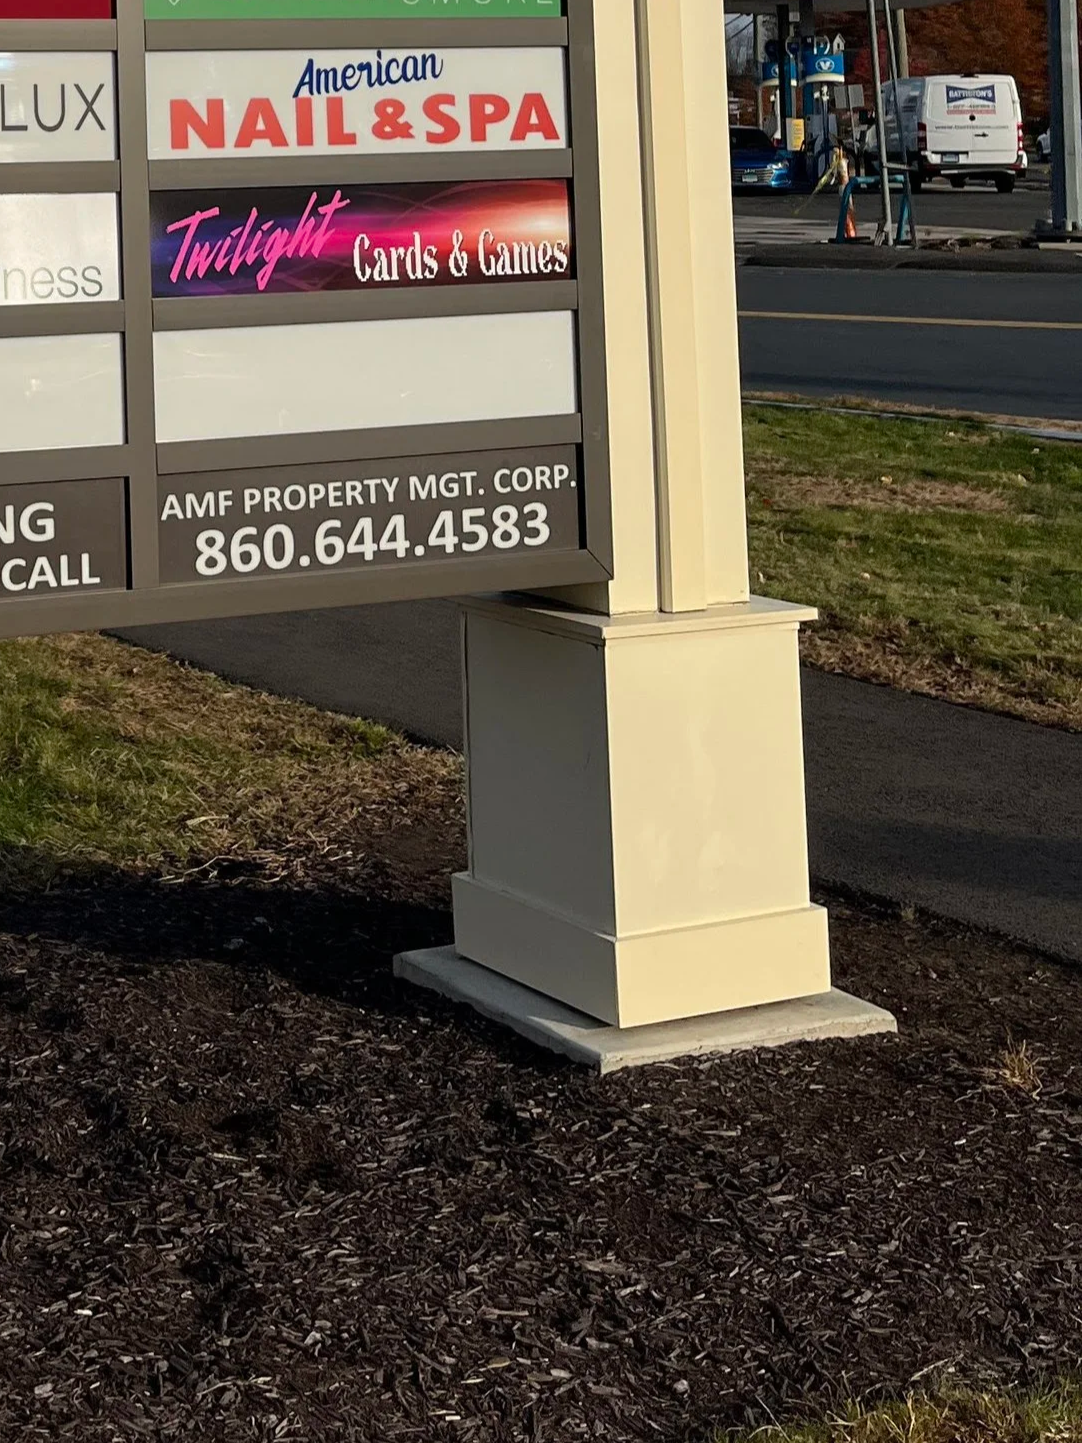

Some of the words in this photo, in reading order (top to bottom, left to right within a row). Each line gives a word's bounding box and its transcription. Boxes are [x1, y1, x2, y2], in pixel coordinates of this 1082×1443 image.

[292, 49, 444, 98] American
[0, 83, 106, 132] LUX
[166, 188, 351, 291] Twilight
[353, 232, 438, 282] Cards
[448, 229, 468, 278] &
[478, 228, 568, 277] Games
[160, 489, 234, 521] AMF
[243, 476, 399, 514] PROPERTY
[408, 470, 486, 501] MGT.
[493, 463, 578, 494] CORP.
[194, 501, 551, 577] 860.644.4583
[1, 553, 101, 591] CALL
